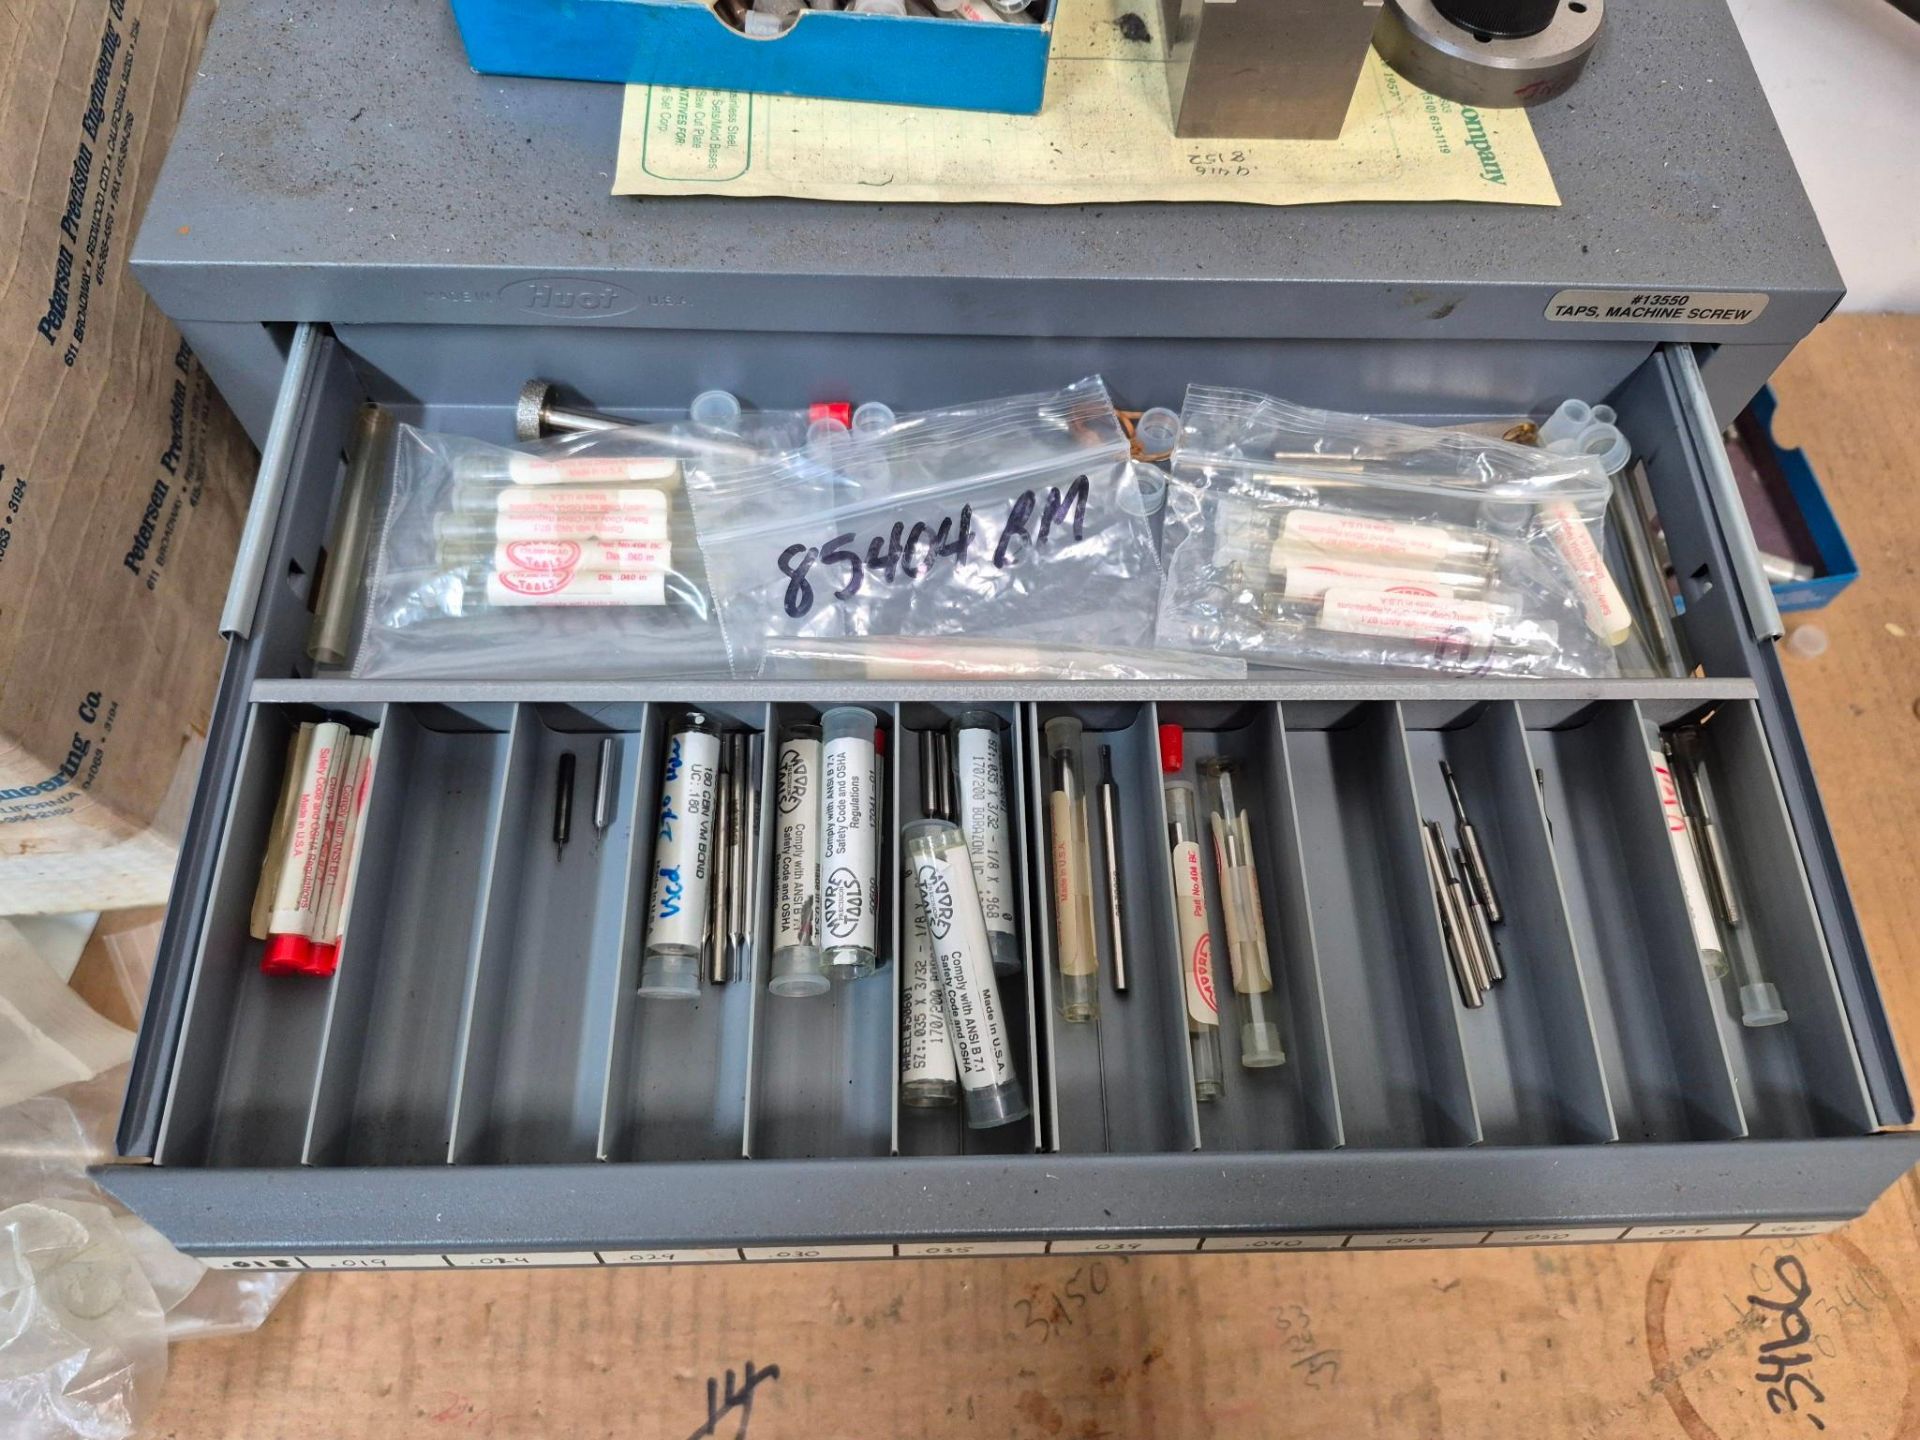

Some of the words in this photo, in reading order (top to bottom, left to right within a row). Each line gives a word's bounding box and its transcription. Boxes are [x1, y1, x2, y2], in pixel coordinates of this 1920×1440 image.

[661, 94, 673, 110] Set
[695, 90, 707, 109] Saw
[694, 111, 706, 127] Cut
[692, 128, 705, 149] Plate
[727, 125, 740, 150] Steel,
[1427, 115, 1450, 155] 613-1119
[1460, 105, 1507, 186] ompany
[708, 143, 721, 170] Bases
[37, 242, 73, 346] Petersen
[61, 142, 93, 245] Precision
[82, 18, 121, 143] Engineering
[64, 342, 79, 367] 611
[74, 268, 91, 344] BROADWAY
[87, 192, 106, 259] REDWOOD
[101, 153, 112, 193] CITY
[107, 87, 127, 152] CALIFORNIA
[1554, 306, 1600, 318] TAPS,
[1606, 307, 1683, 319] MACHINE
[1687, 308, 1752, 320] SCREW
[1631, 294, 1690, 306] #13550
[124, 479, 169, 576] Petersen
[160, 379, 186, 476] Precision
[8, 478, 28, 514] 3194
[156, 495, 181, 567] BROADWAY
[777, 503, 977, 618] 85404
[77, 690, 102, 725] Co.
[316, 748, 331, 777] Safety
[836, 751, 847, 779] OSHA
[972, 757, 985, 798] 170/200
[312, 777, 327, 801] Code
[787, 754, 808, 805] MOORE
[825, 777, 835, 800] ANSI
[836, 780, 846, 797] and
[825, 801, 835, 821] with
[836, 799, 847, 822] Code
[849, 775, 862, 829] Regulations
[987, 801, 999, 829] 3/32
[782, 825, 793, 855] Safety
[792, 823, 806, 858] Comply
[824, 822, 836, 858] Comply
[836, 824, 849, 854] Safety
[971, 807, 985, 855] BORAZON
[696, 842, 708, 880] BOND
[781, 857, 792, 882] Code
[793, 858, 805, 880] with
[987, 849, 999, 868] 1/8
[781, 884, 791, 900] and
[792, 882, 804, 905] ANSI
[824, 877, 842, 931] MOORE
[843, 878, 863, 925] TOOLS
[930, 866, 954, 931] MOORE
[987, 888, 1000, 918] .968
[780, 902, 792, 932] OSHA
[1193, 897, 1203, 918] Part
[913, 960, 927, 991] 3/32
[941, 954, 952, 988] Safety
[950, 951, 967, 990] Comply
[948, 987, 959, 1016] Code
[960, 991, 971, 1017] with
[981, 988, 995, 1020] Made
[953, 1017, 964, 1038] and
[965, 1016, 979, 1047] ANSI
[988, 1021, 998, 1033] in
[958, 1040, 971, 1074] OSHA
[975, 1057, 985, 1073] 7.1
[992, 1036, 1006, 1075] U.S.A.
[1246, 1238, 1303, 1248] .040
[331, 1257, 387, 1268] .019
